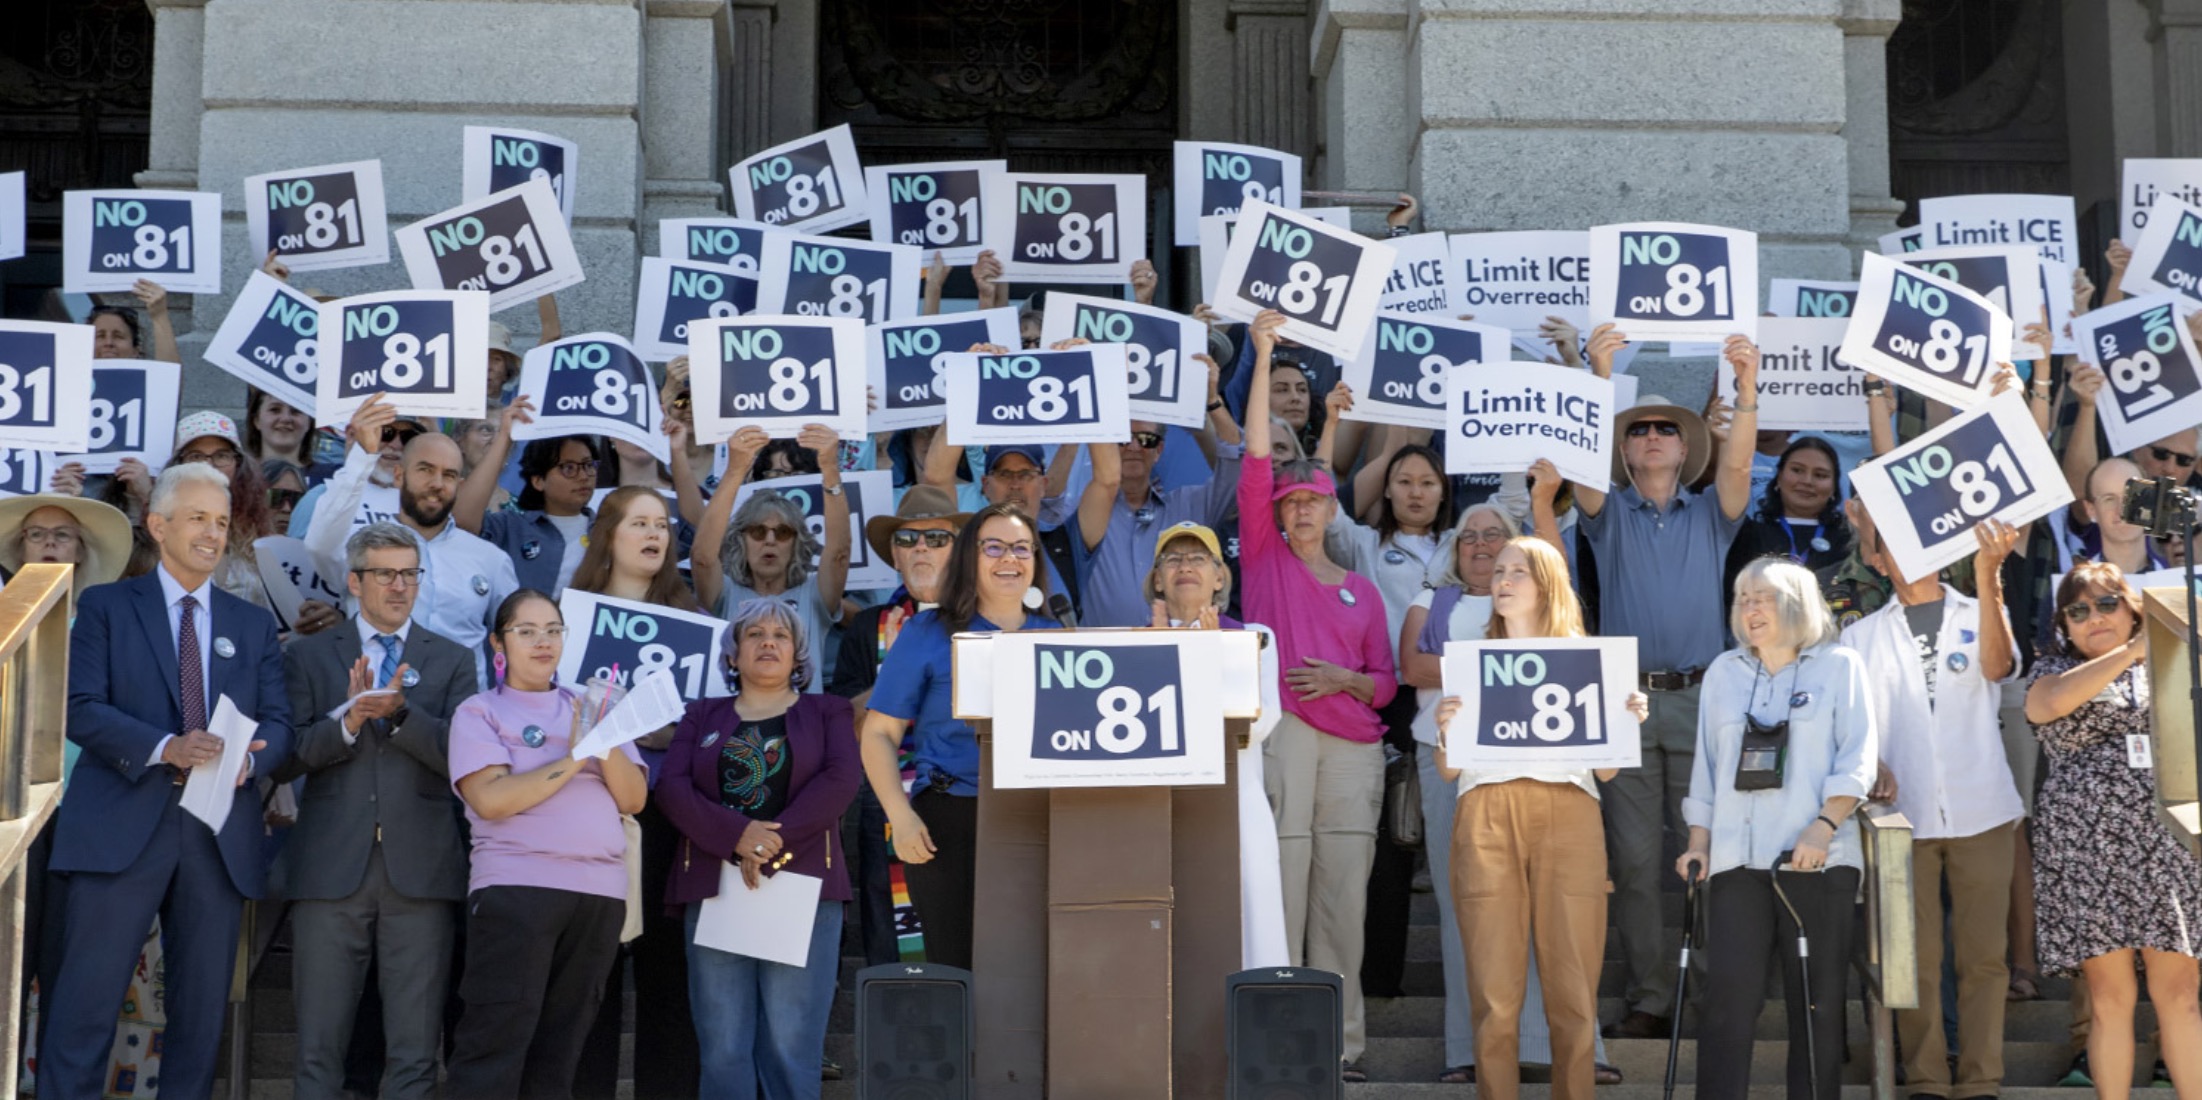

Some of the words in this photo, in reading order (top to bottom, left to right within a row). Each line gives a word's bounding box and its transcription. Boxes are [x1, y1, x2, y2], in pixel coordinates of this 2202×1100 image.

[495, 139, 540, 168] NO
[1205, 154, 1251, 182] NO
[751, 156, 793, 191] NO
[890, 175, 937, 204] NO
[269, 179, 315, 209] NO
[764, 207, 788, 224] ON
[785, 165, 840, 217] 81
[1020, 186, 1072, 214] NO
[2134, 184, 2202, 208] Liit
[96, 201, 148, 227] NO
[277, 234, 304, 250] ON
[304, 198, 361, 249] 81
[901, 229, 925, 245] ON
[925, 197, 978, 245] 81
[2177, 215, 2202, 248] N
[102, 253, 130, 268] ON
[132, 225, 191, 269] 81
[429, 216, 485, 257] NO
[691, 229, 740, 255] NO
[1026, 242, 1054, 258] ON
[1057, 212, 1115, 261] 81
[1259, 218, 1313, 259] NO
[1936, 220, 2009, 246] Limit
[2018, 219, 2062, 243] ICE
[457, 274, 488, 291] ON
[479, 223, 547, 285] 81
[793, 245, 846, 276] NO
[1622, 235, 1681, 266] NO
[671, 271, 724, 300] NO
[1409, 259, 1444, 288] ICE
[1466, 256, 1540, 282] Limit
[1548, 256, 1590, 282] ICE
[2168, 268, 2197, 291] ON
[796, 301, 825, 317] ON
[828, 274, 887, 324] 81
[1250, 280, 1277, 303] ON
[1278, 261, 1350, 326] 81
[1384, 288, 1448, 313] reach!
[1466, 285, 1590, 306] Overreach!
[1629, 296, 1662, 313] ON
[1664, 263, 1729, 317] 81
[1800, 292, 1849, 317] NO
[1893, 275, 1949, 317] NO
[268, 296, 318, 337] NO
[345, 305, 399, 341] NO
[1077, 309, 1134, 343] NO
[2140, 306, 2177, 354] NO
[724, 328, 783, 362] NO
[886, 328, 941, 359] NO
[1379, 322, 1434, 355] NO
[1888, 334, 1920, 360] ON
[1921, 318, 1987, 385] 81
[253, 345, 281, 369] ON
[350, 370, 377, 390] ON
[380, 333, 450, 388] 81
[553, 343, 610, 371] NO
[982, 355, 1041, 380] NO
[1755, 344, 1813, 371] mit
[1822, 345, 1864, 371] IC
[733, 393, 765, 411] ON
[768, 357, 834, 412] 81
[900, 384, 929, 402] ON
[1384, 381, 1413, 399] ON
[1416, 354, 1480, 405] 8
[1733, 375, 1867, 396] verreach!
[2100, 334, 2120, 361] ON
[2110, 350, 2175, 417] 81
[556, 396, 587, 411] ON
[590, 369, 648, 427] 81
[992, 405, 1024, 420] ON
[1027, 375, 1095, 422] 81
[1462, 387, 1546, 415] Limit
[1556, 391, 1600, 428] ICE
[88, 398, 141, 450] 81
[1461, 418, 1599, 453] Overreach!
[0, 448, 37, 493] 1
[1890, 445, 1953, 496] NO
[1930, 508, 1965, 537] ON
[1949, 442, 2029, 517] 81
[595, 608, 658, 643] NO
[632, 643, 706, 700] 81
[1040, 649, 1114, 689] NO
[1484, 653, 1547, 686] NO
[1051, 729, 1091, 751] ON
[1095, 684, 1179, 753] 81
[1493, 721, 1528, 740] ON
[1531, 682, 1602, 741] 81
